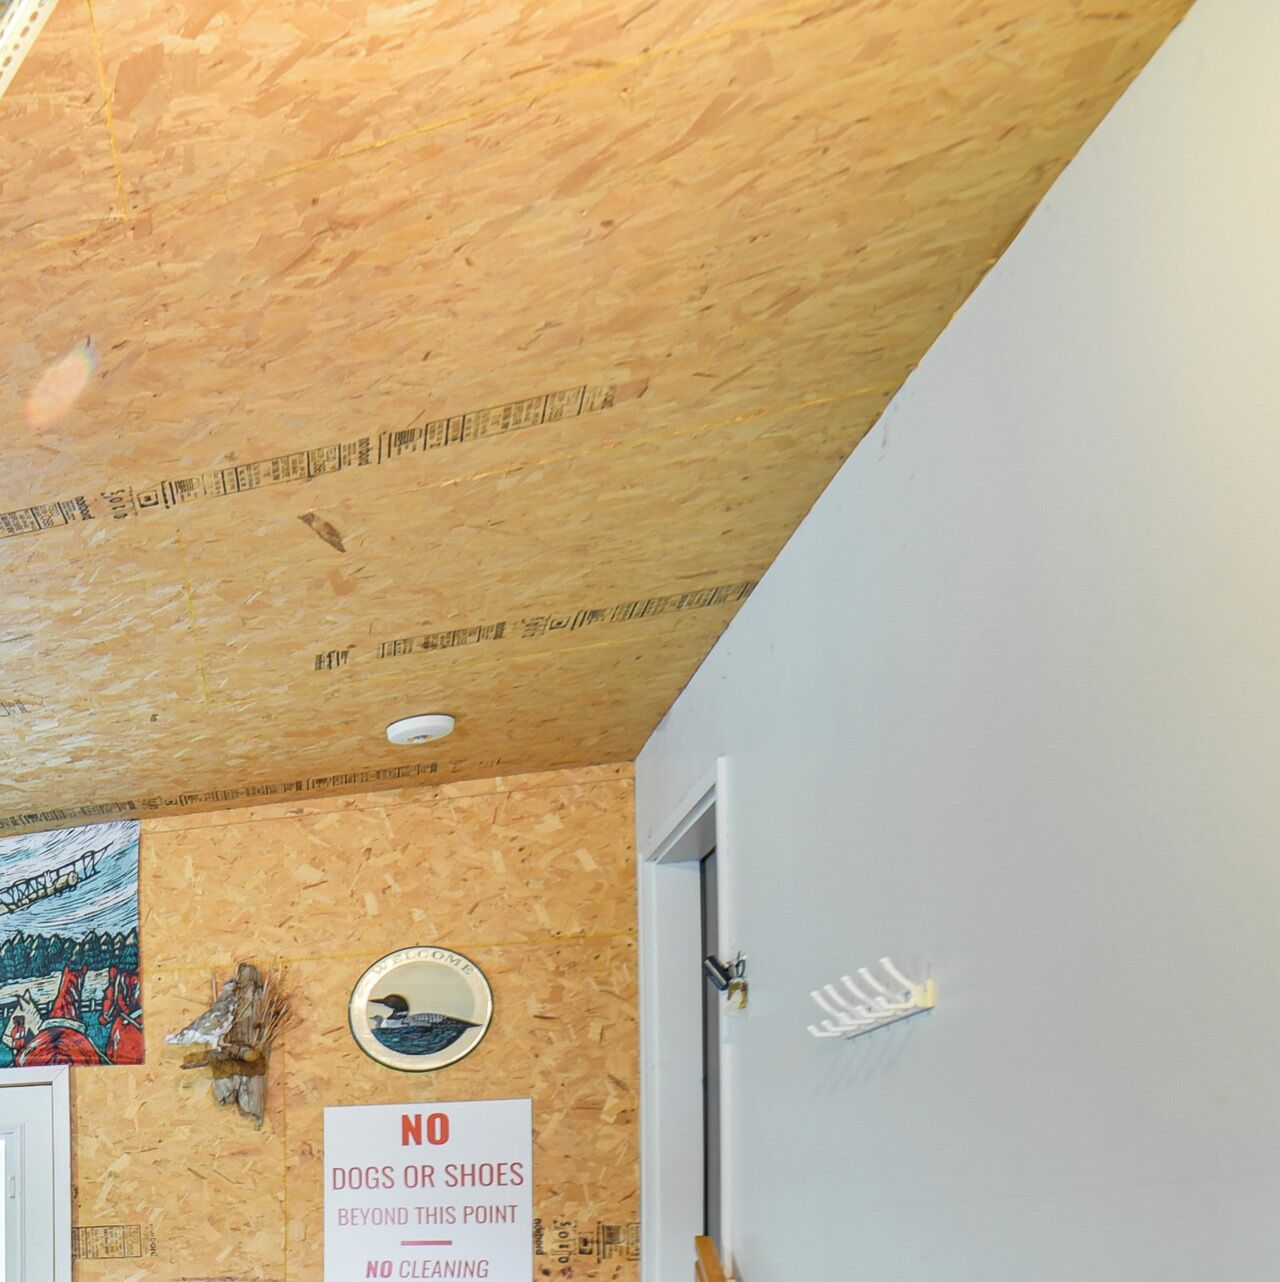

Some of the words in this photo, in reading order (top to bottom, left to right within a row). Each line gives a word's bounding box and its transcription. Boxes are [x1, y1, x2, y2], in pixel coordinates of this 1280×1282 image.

[371, 950, 474, 975] WELCOME
[401, 1113, 450, 1146] NO
[332, 1165, 395, 1190] DOGS
[403, 1165, 435, 1188] OR
[445, 1162, 524, 1188] SHOES
[337, 1206, 408, 1227] BEYOND
[415, 1206, 456, 1225] THIS
[463, 1205, 518, 1225] POINT
[365, 1260, 393, 1279] NO
[399, 1259, 489, 1279] CLEANING
